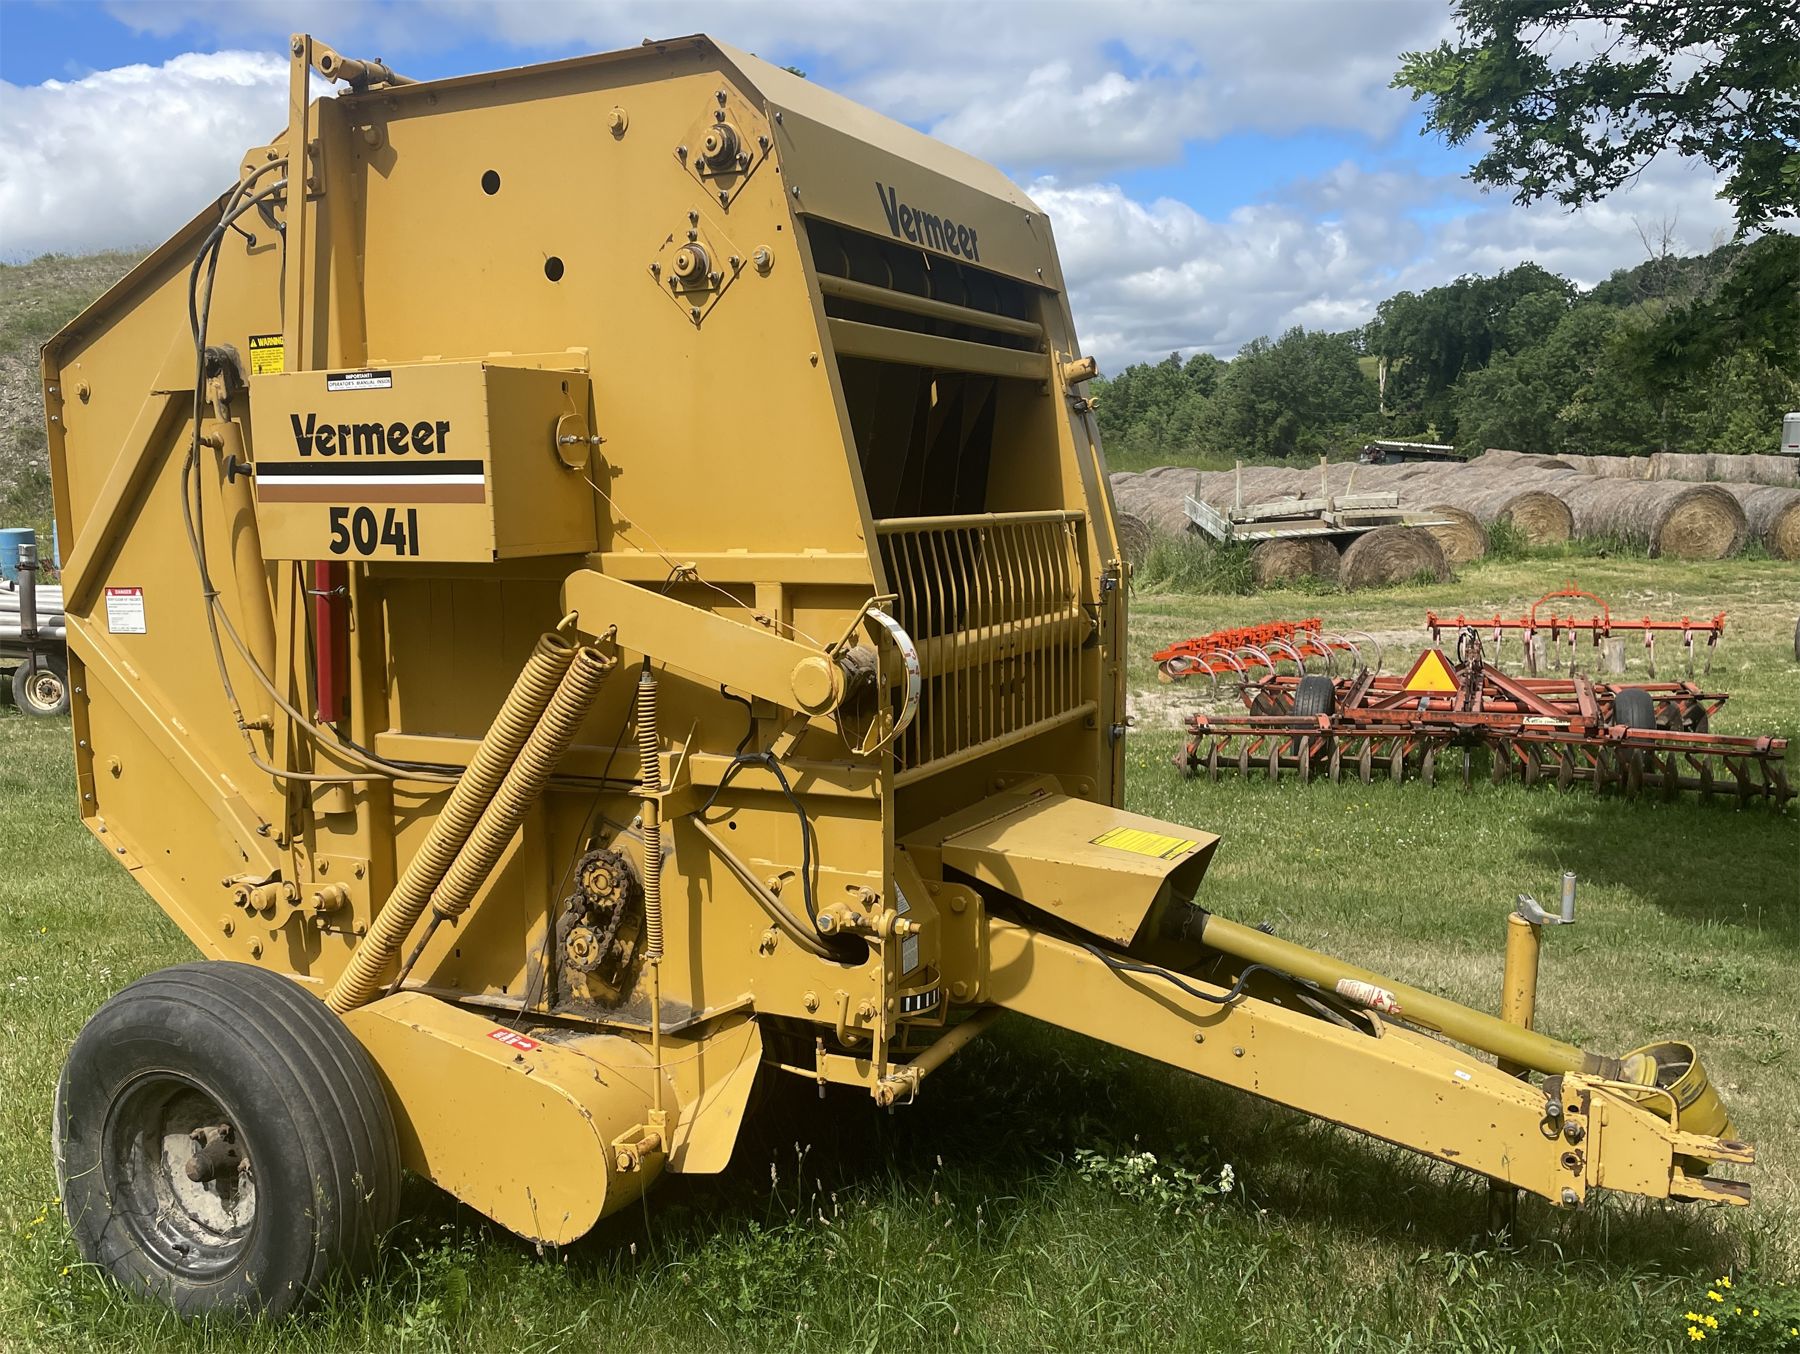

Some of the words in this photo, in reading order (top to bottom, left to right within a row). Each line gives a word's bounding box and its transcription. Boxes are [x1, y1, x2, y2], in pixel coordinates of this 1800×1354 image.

[876, 181, 980, 262] Vermeer
[257, 336, 284, 347] WARNING
[290, 413, 450, 456] Vermeer
[329, 506, 420, 556] 5041
